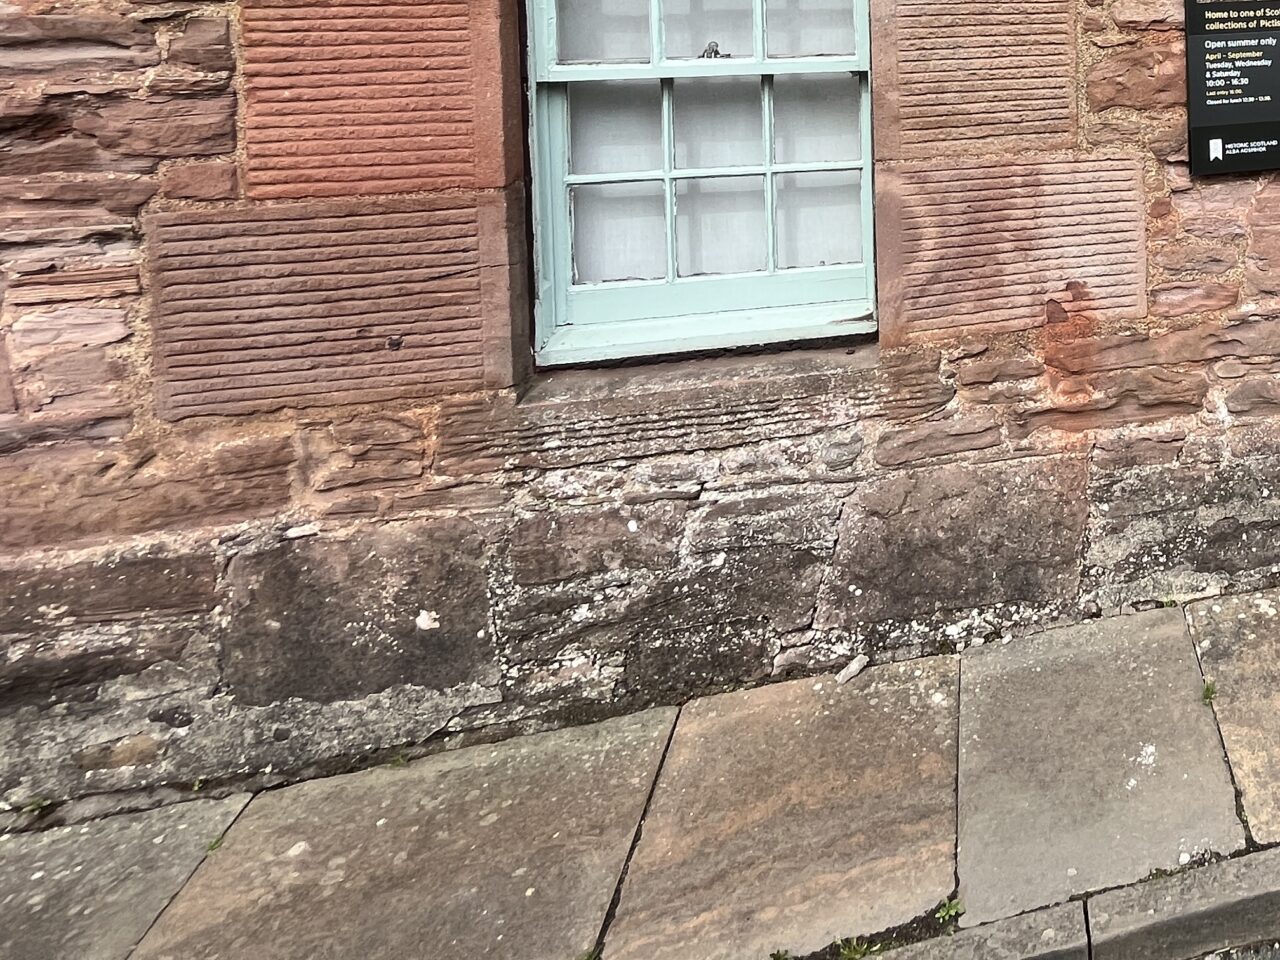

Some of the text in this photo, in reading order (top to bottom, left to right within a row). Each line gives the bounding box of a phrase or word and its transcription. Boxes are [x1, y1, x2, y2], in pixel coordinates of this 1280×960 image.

[1205, 11, 1228, 19] Home
[1230, 10, 1238, 18] to
[1256, 8, 1264, 16] of
[1205, 21, 1247, 30] collections
[1248, 20, 1257, 28] of
[1204, 37, 1277, 49] Open summer only
[1227, 51, 1263, 59] September
[1205, 59, 1272, 69] Tuesday, Wednesday
[1212, 70, 1241, 78] Saturday
[1206, 79, 1225, 87] 10:00
